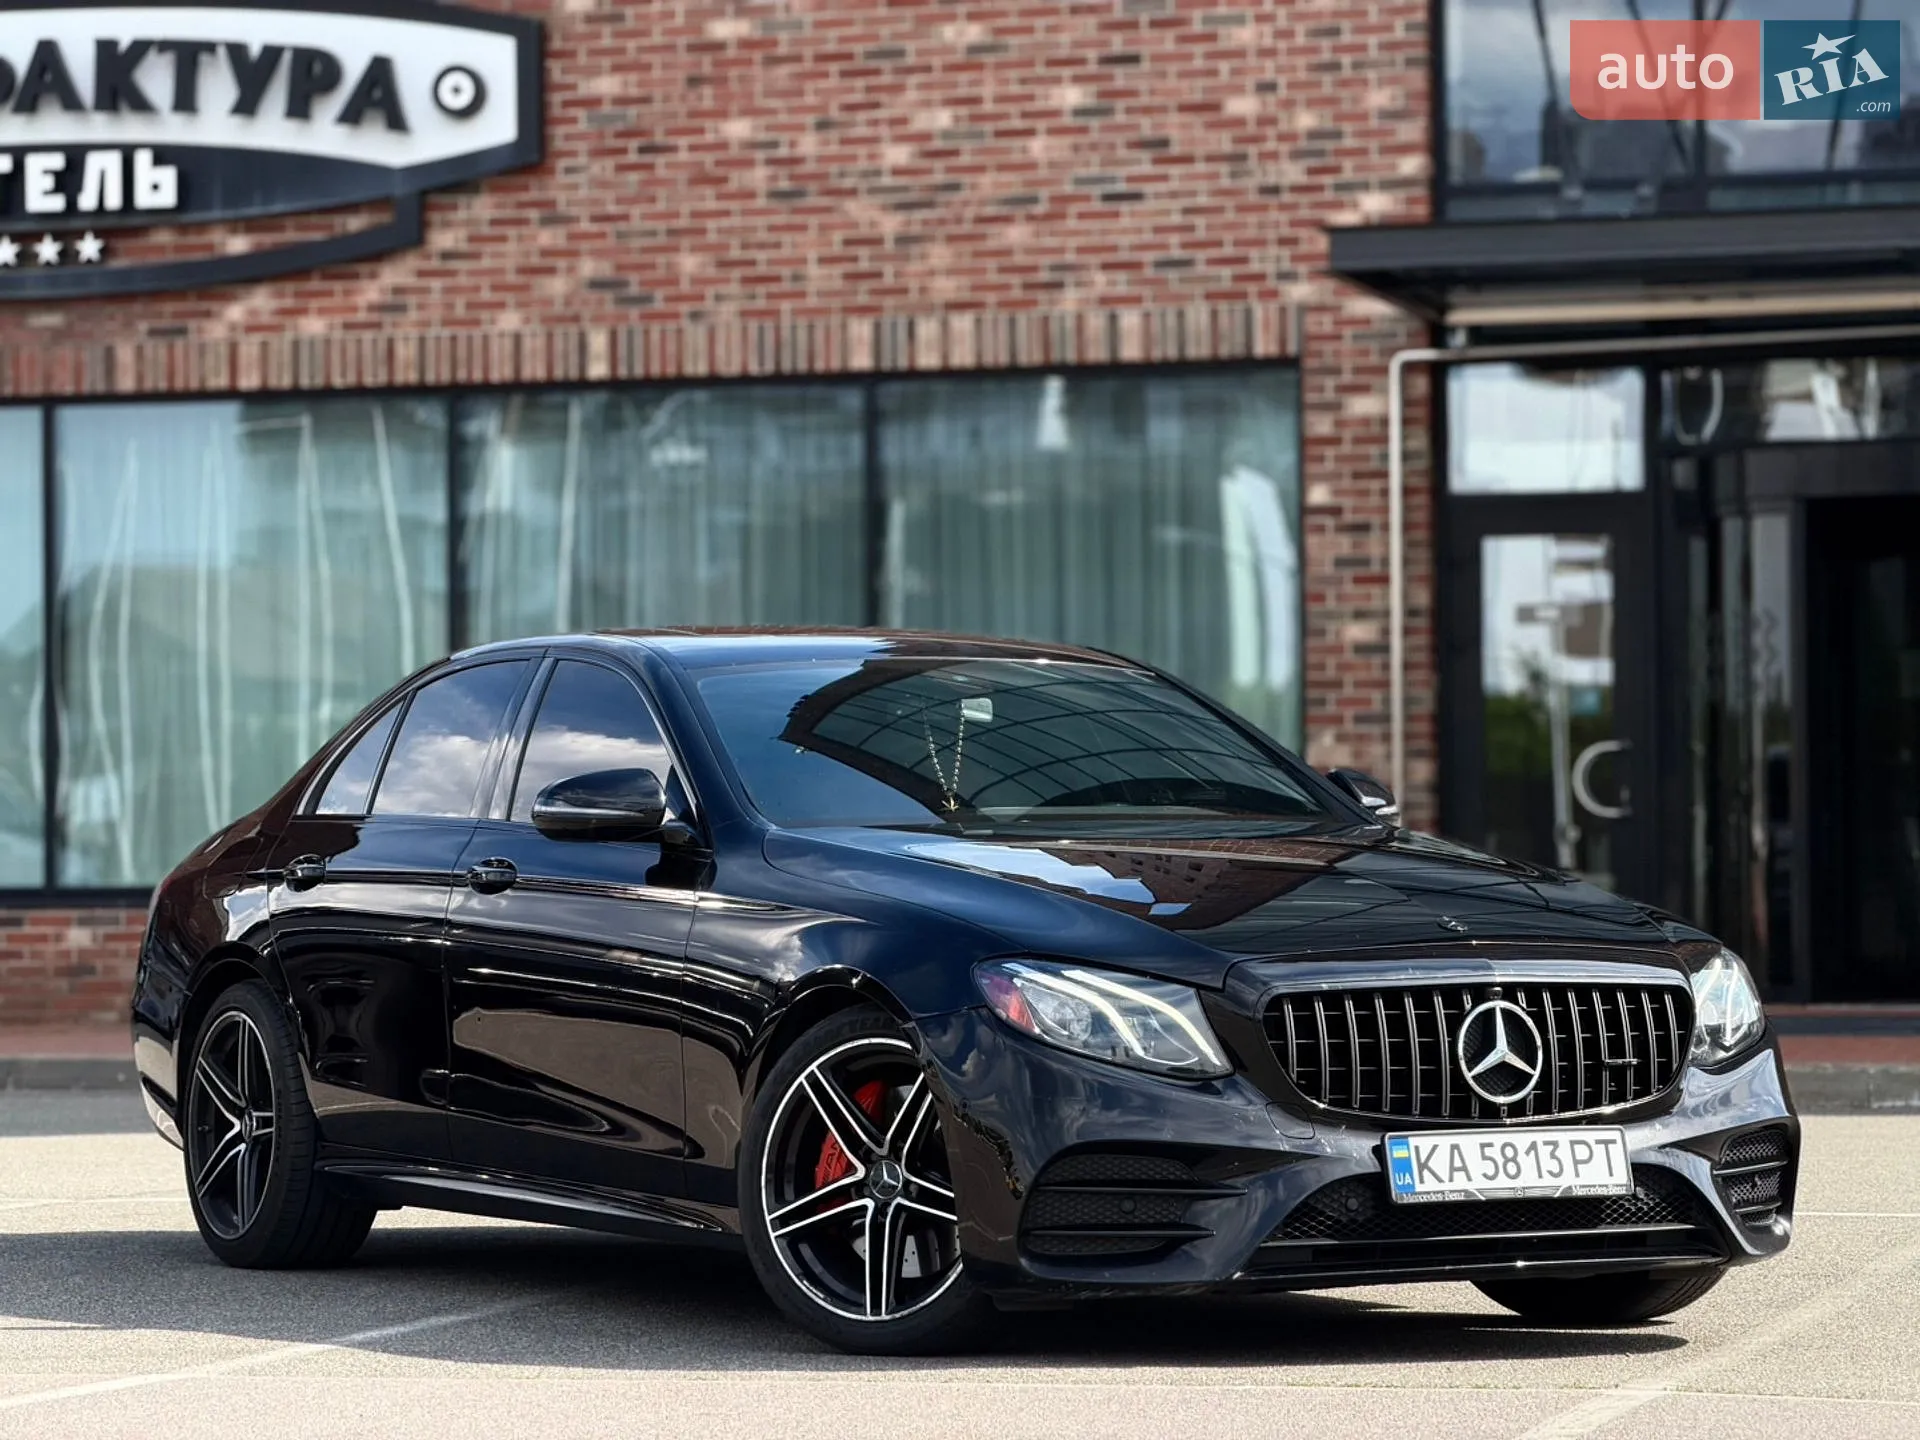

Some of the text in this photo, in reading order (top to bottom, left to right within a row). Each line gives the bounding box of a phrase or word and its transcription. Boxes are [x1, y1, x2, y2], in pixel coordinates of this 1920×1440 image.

[1414, 1139, 1618, 1184] KA 5813 PT
[1395, 1173, 1413, 1185] UA
